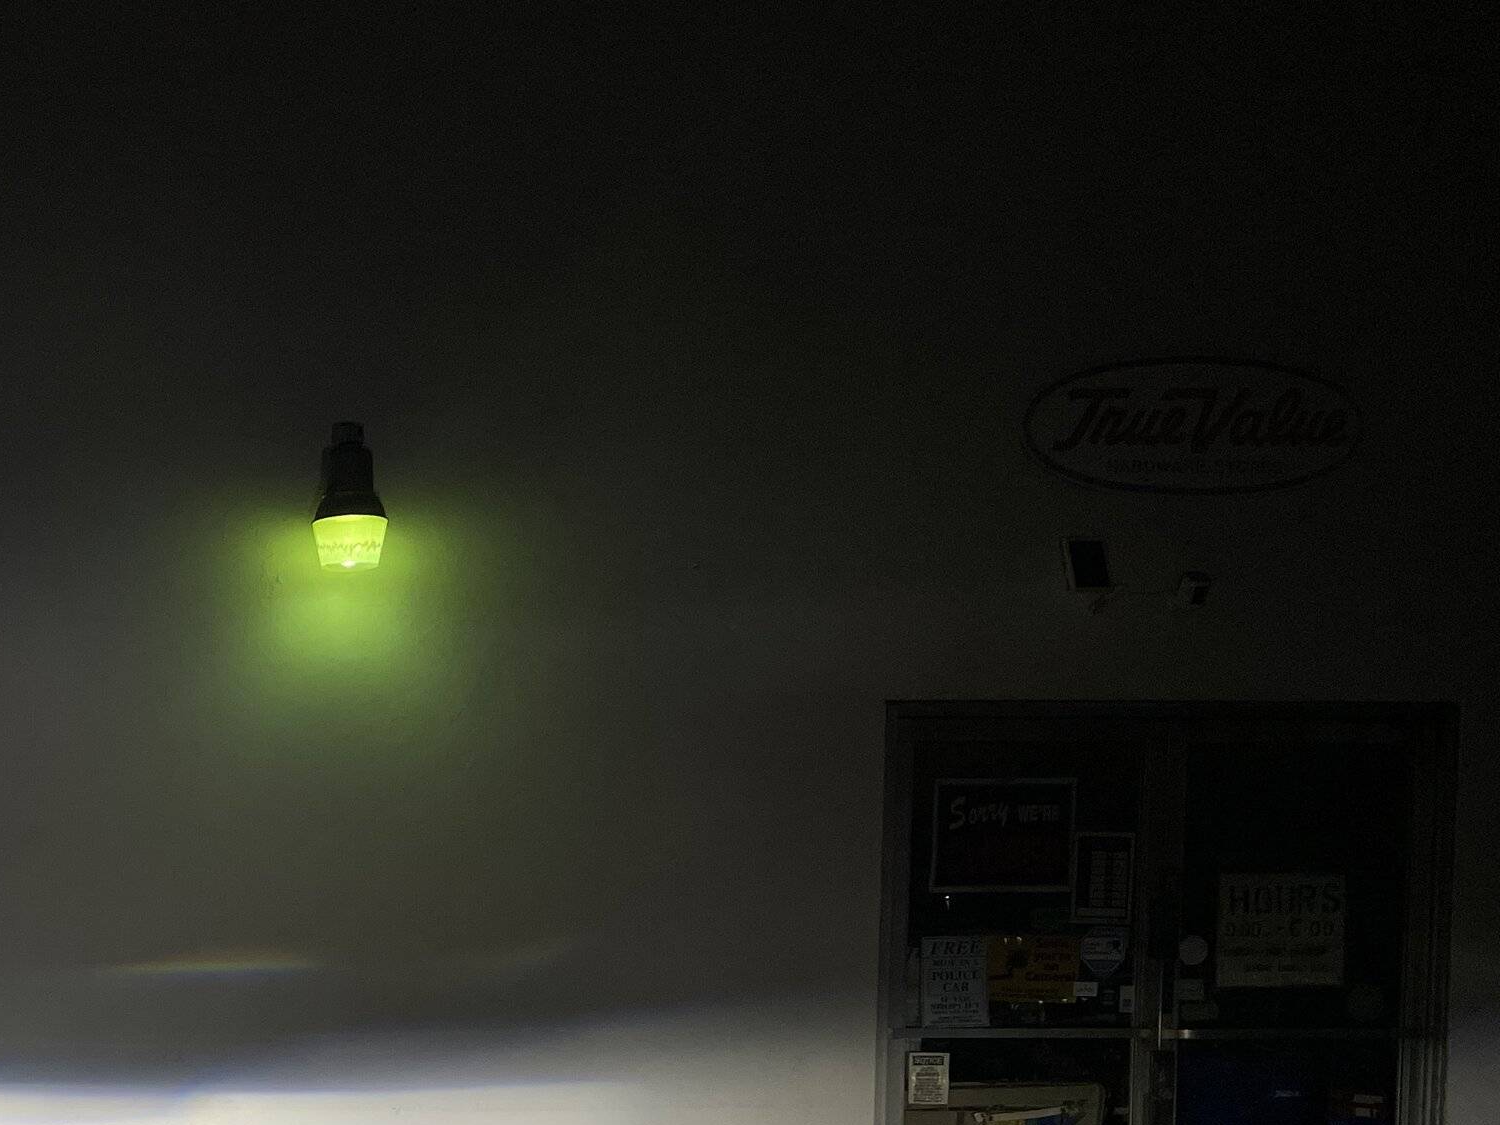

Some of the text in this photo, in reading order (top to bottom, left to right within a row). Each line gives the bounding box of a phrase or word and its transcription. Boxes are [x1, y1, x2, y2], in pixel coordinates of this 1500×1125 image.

[1052, 387, 1348, 455] True Value
[1229, 882, 1339, 914] HOURS
[931, 941, 982, 955] FREE
[932, 971, 979, 981] POLICE
[943, 982, 969, 992] CAR
